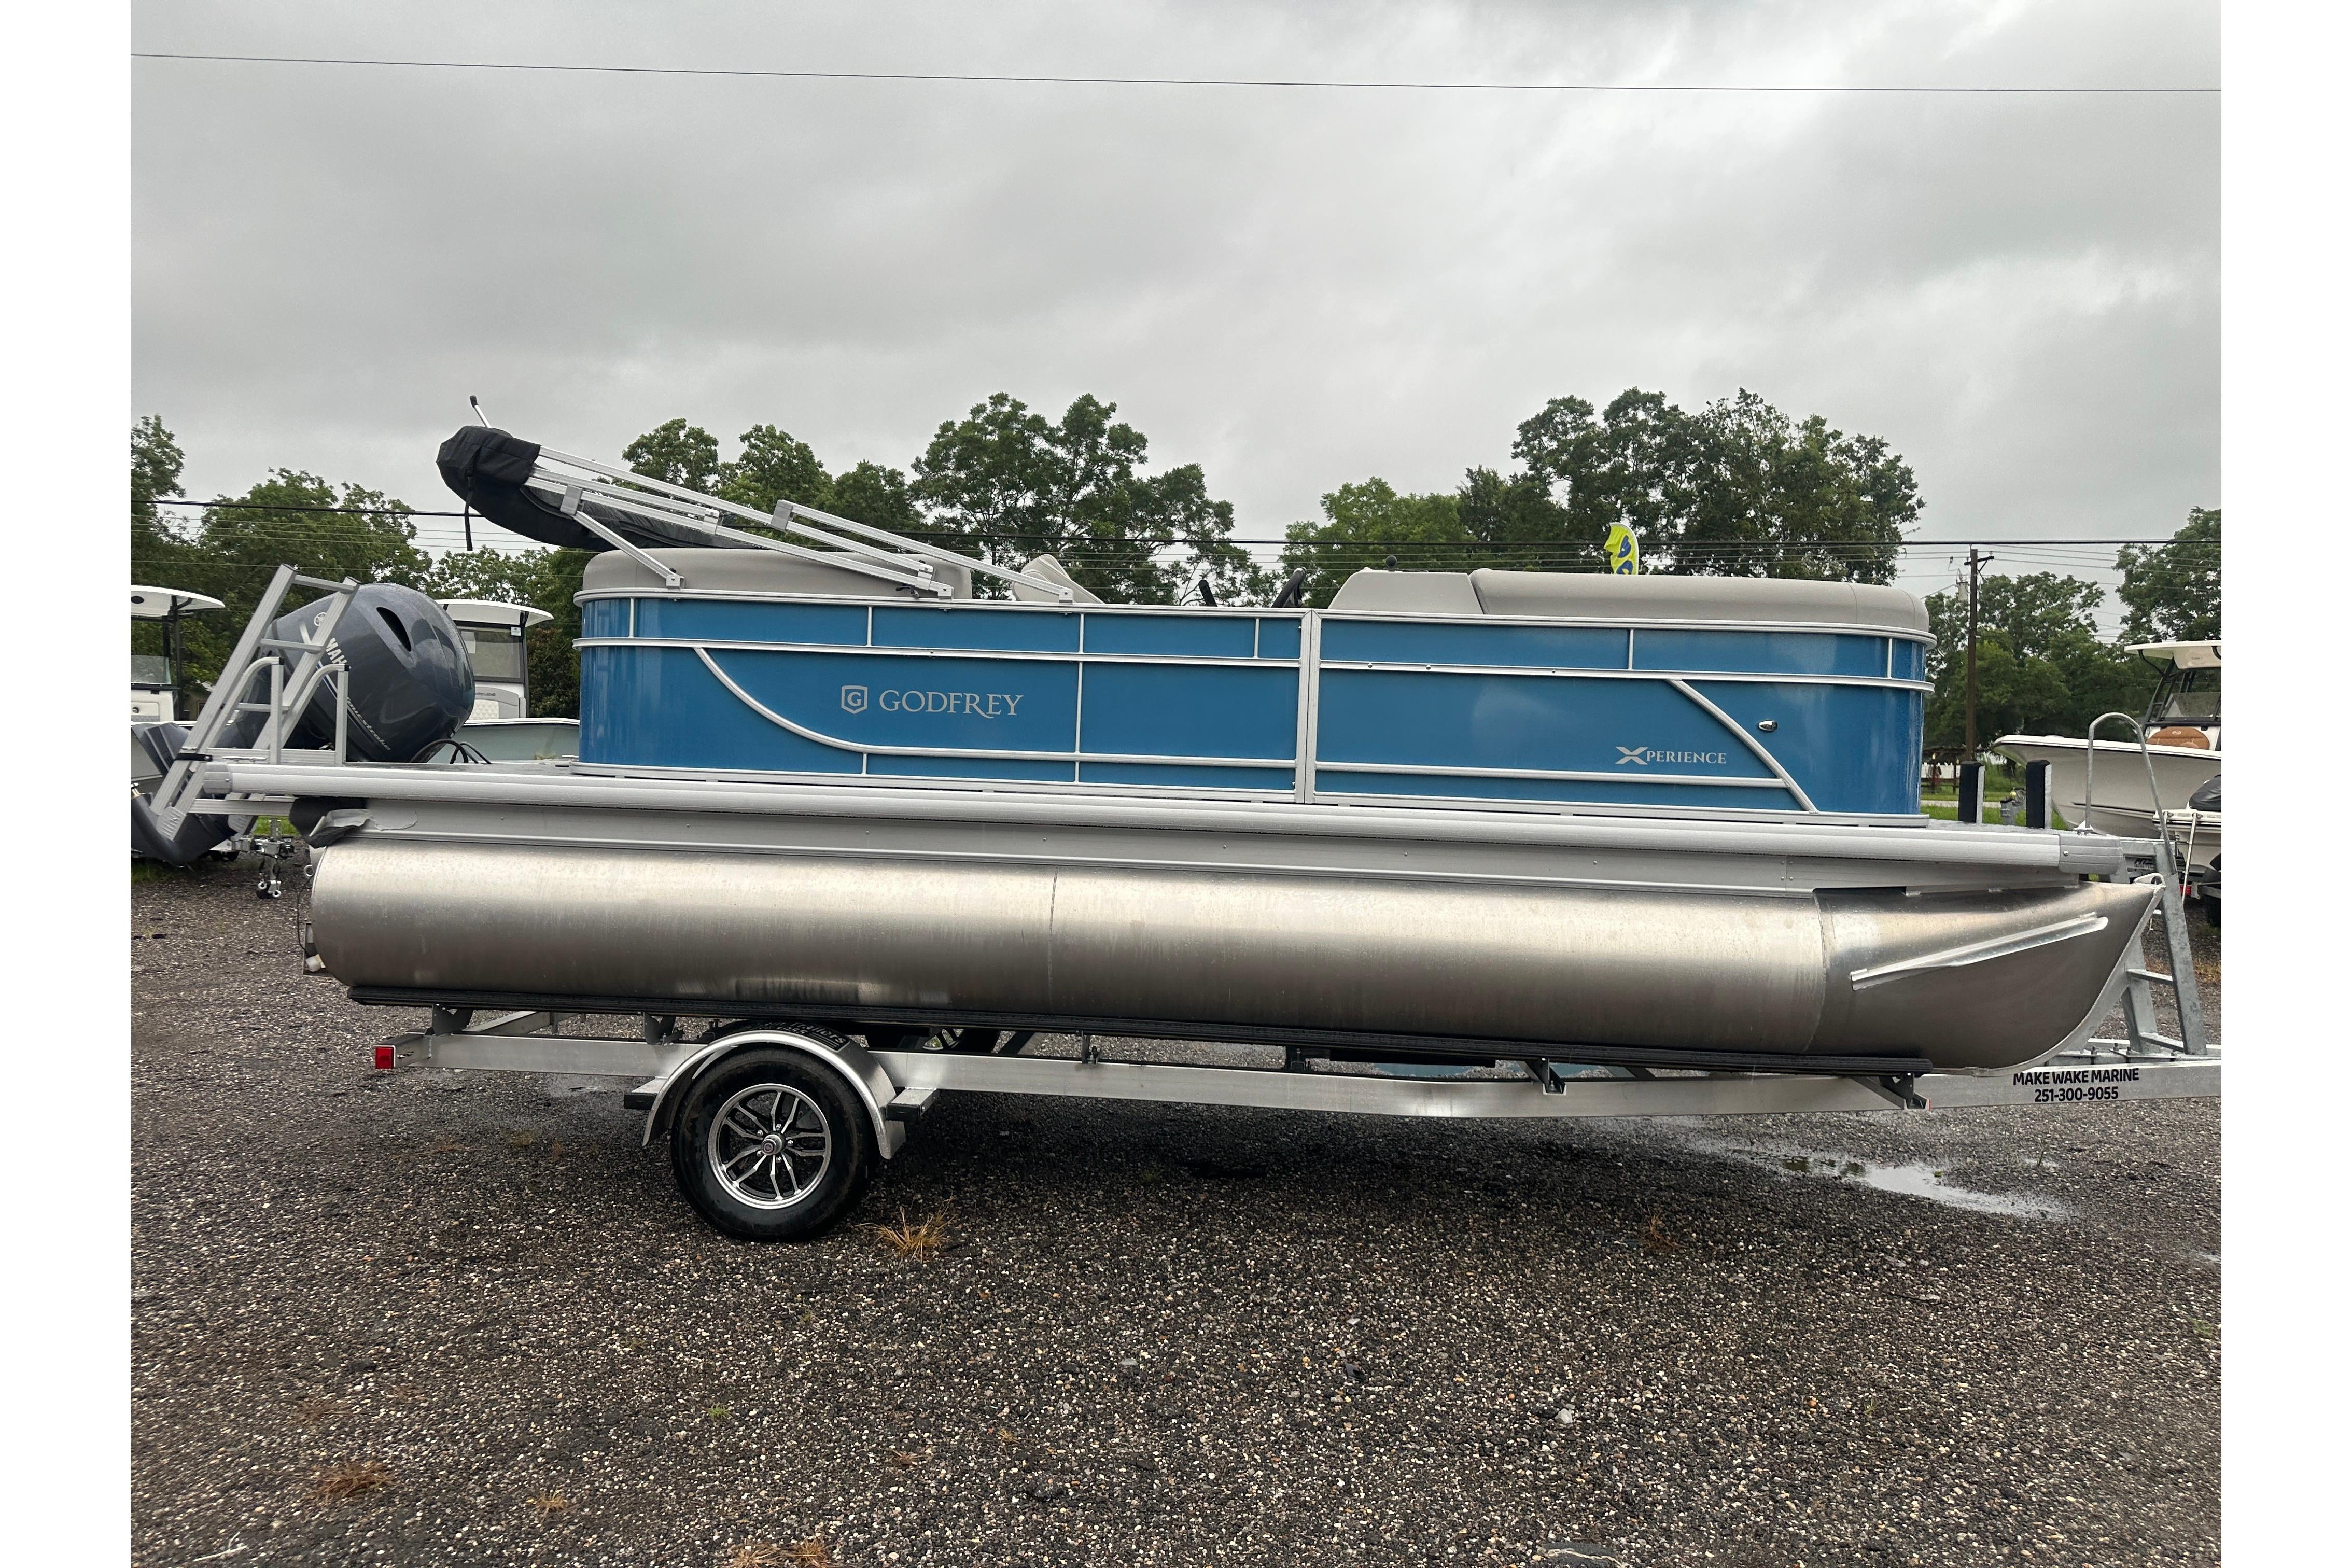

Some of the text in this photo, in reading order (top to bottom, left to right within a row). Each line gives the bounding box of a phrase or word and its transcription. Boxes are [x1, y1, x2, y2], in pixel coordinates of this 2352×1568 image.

[879, 690, 1024, 719] GODFREY
[1615, 746, 1726, 765] XPERIENCE
[2013, 1068, 2139, 1085] MAKE WAKE MARINE
[2035, 1086, 2118, 1102] 251-300-9055
